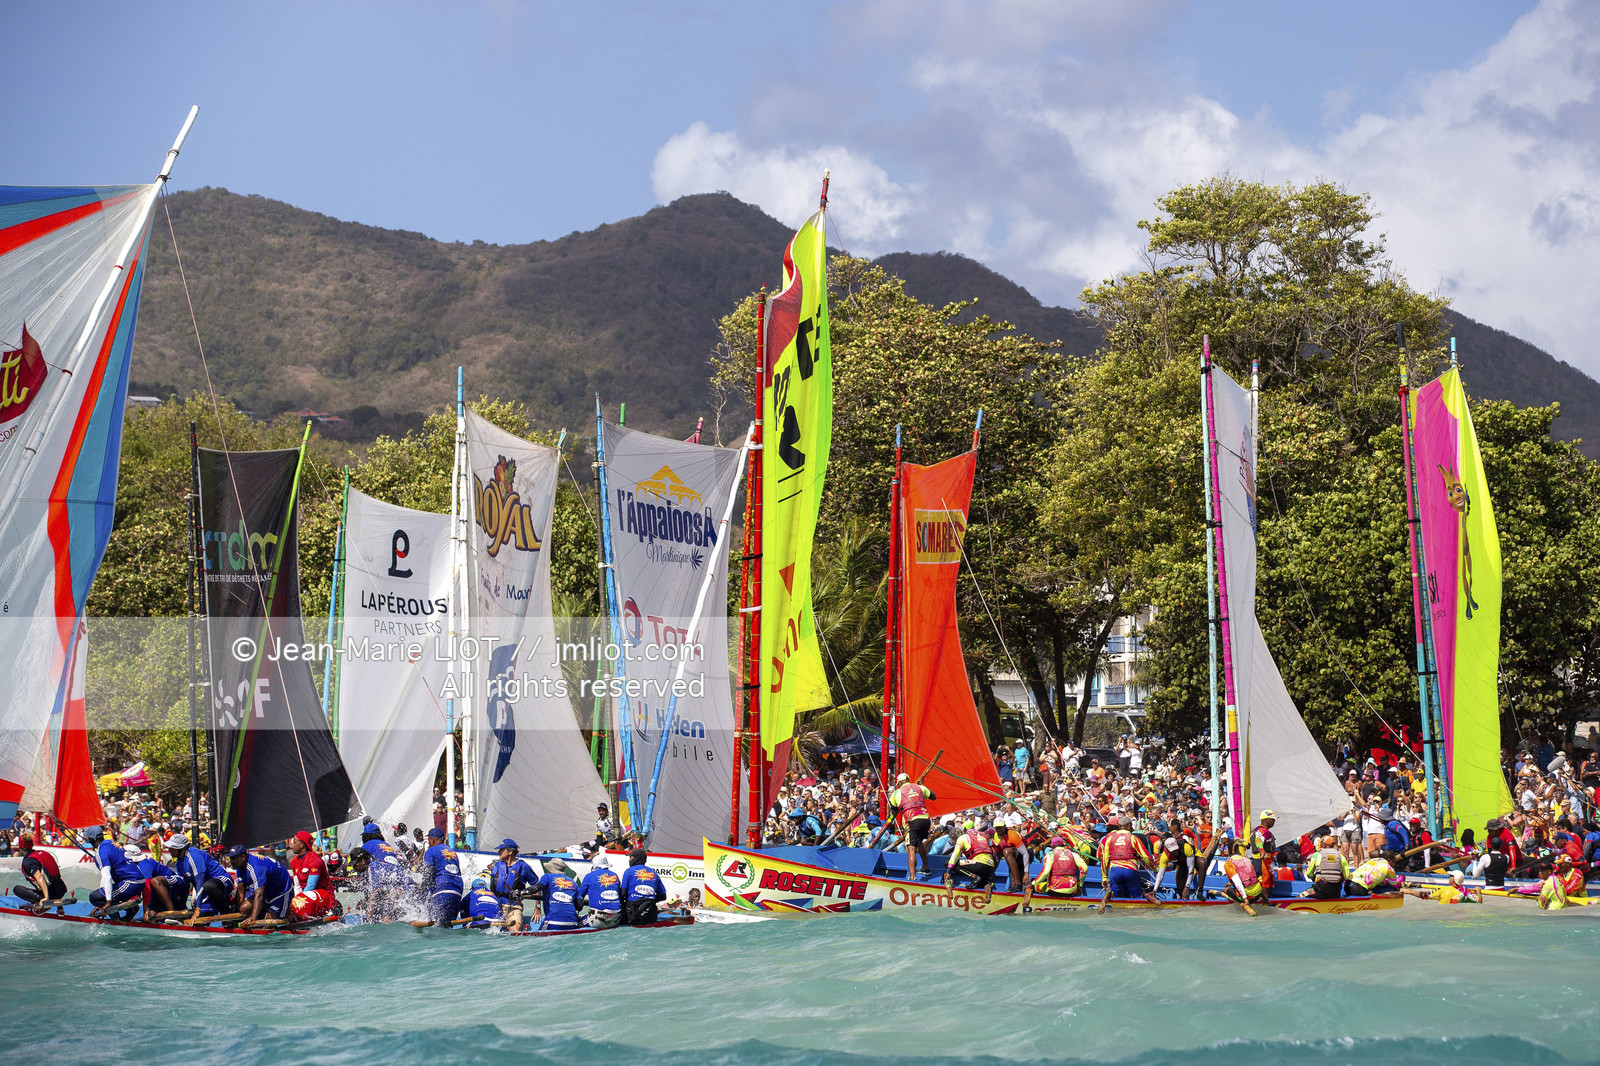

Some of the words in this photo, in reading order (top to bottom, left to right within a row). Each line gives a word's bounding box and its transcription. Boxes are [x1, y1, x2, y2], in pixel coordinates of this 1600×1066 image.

[361, 590, 450, 616] LAPÉROUS
[374, 619, 443, 636] PARTNERS
[759, 868, 868, 900] ROSETTE
[889, 886, 986, 912] Orange
